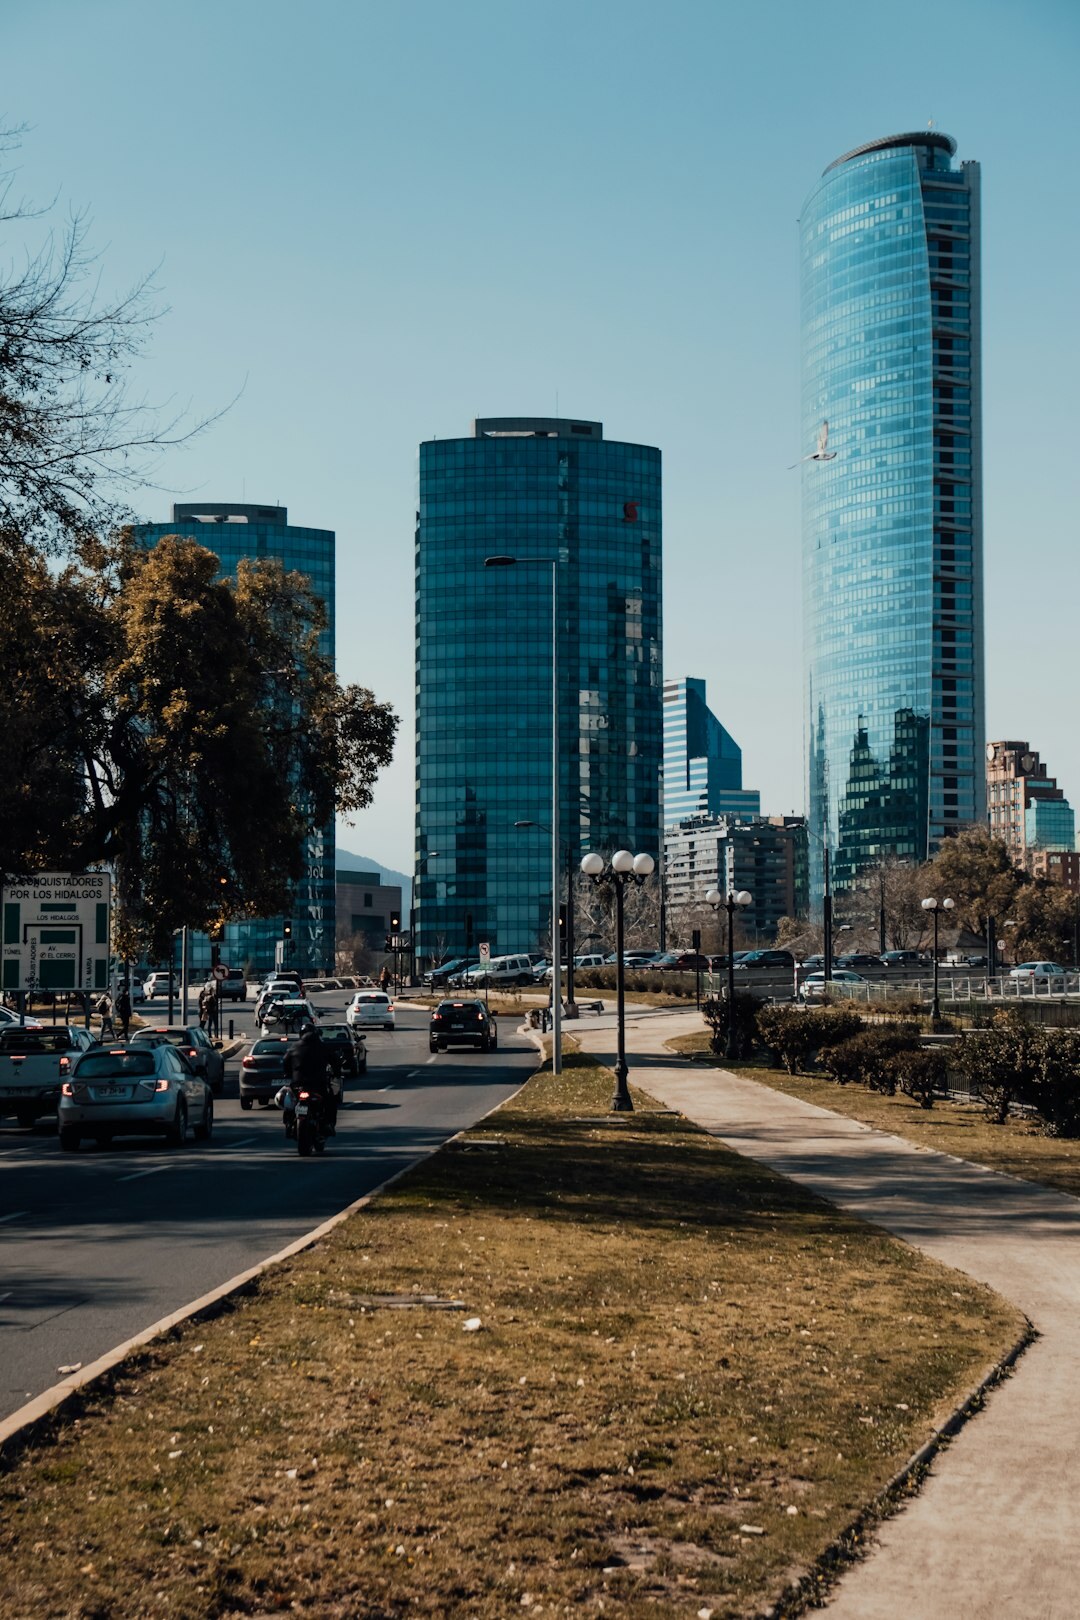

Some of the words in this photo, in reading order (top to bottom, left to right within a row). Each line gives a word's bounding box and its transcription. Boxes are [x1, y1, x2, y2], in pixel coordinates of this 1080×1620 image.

[10, 890, 30, 899] POR
[33, 890, 52, 899] LOS
[54, 890, 102, 899] HIDALGOS
